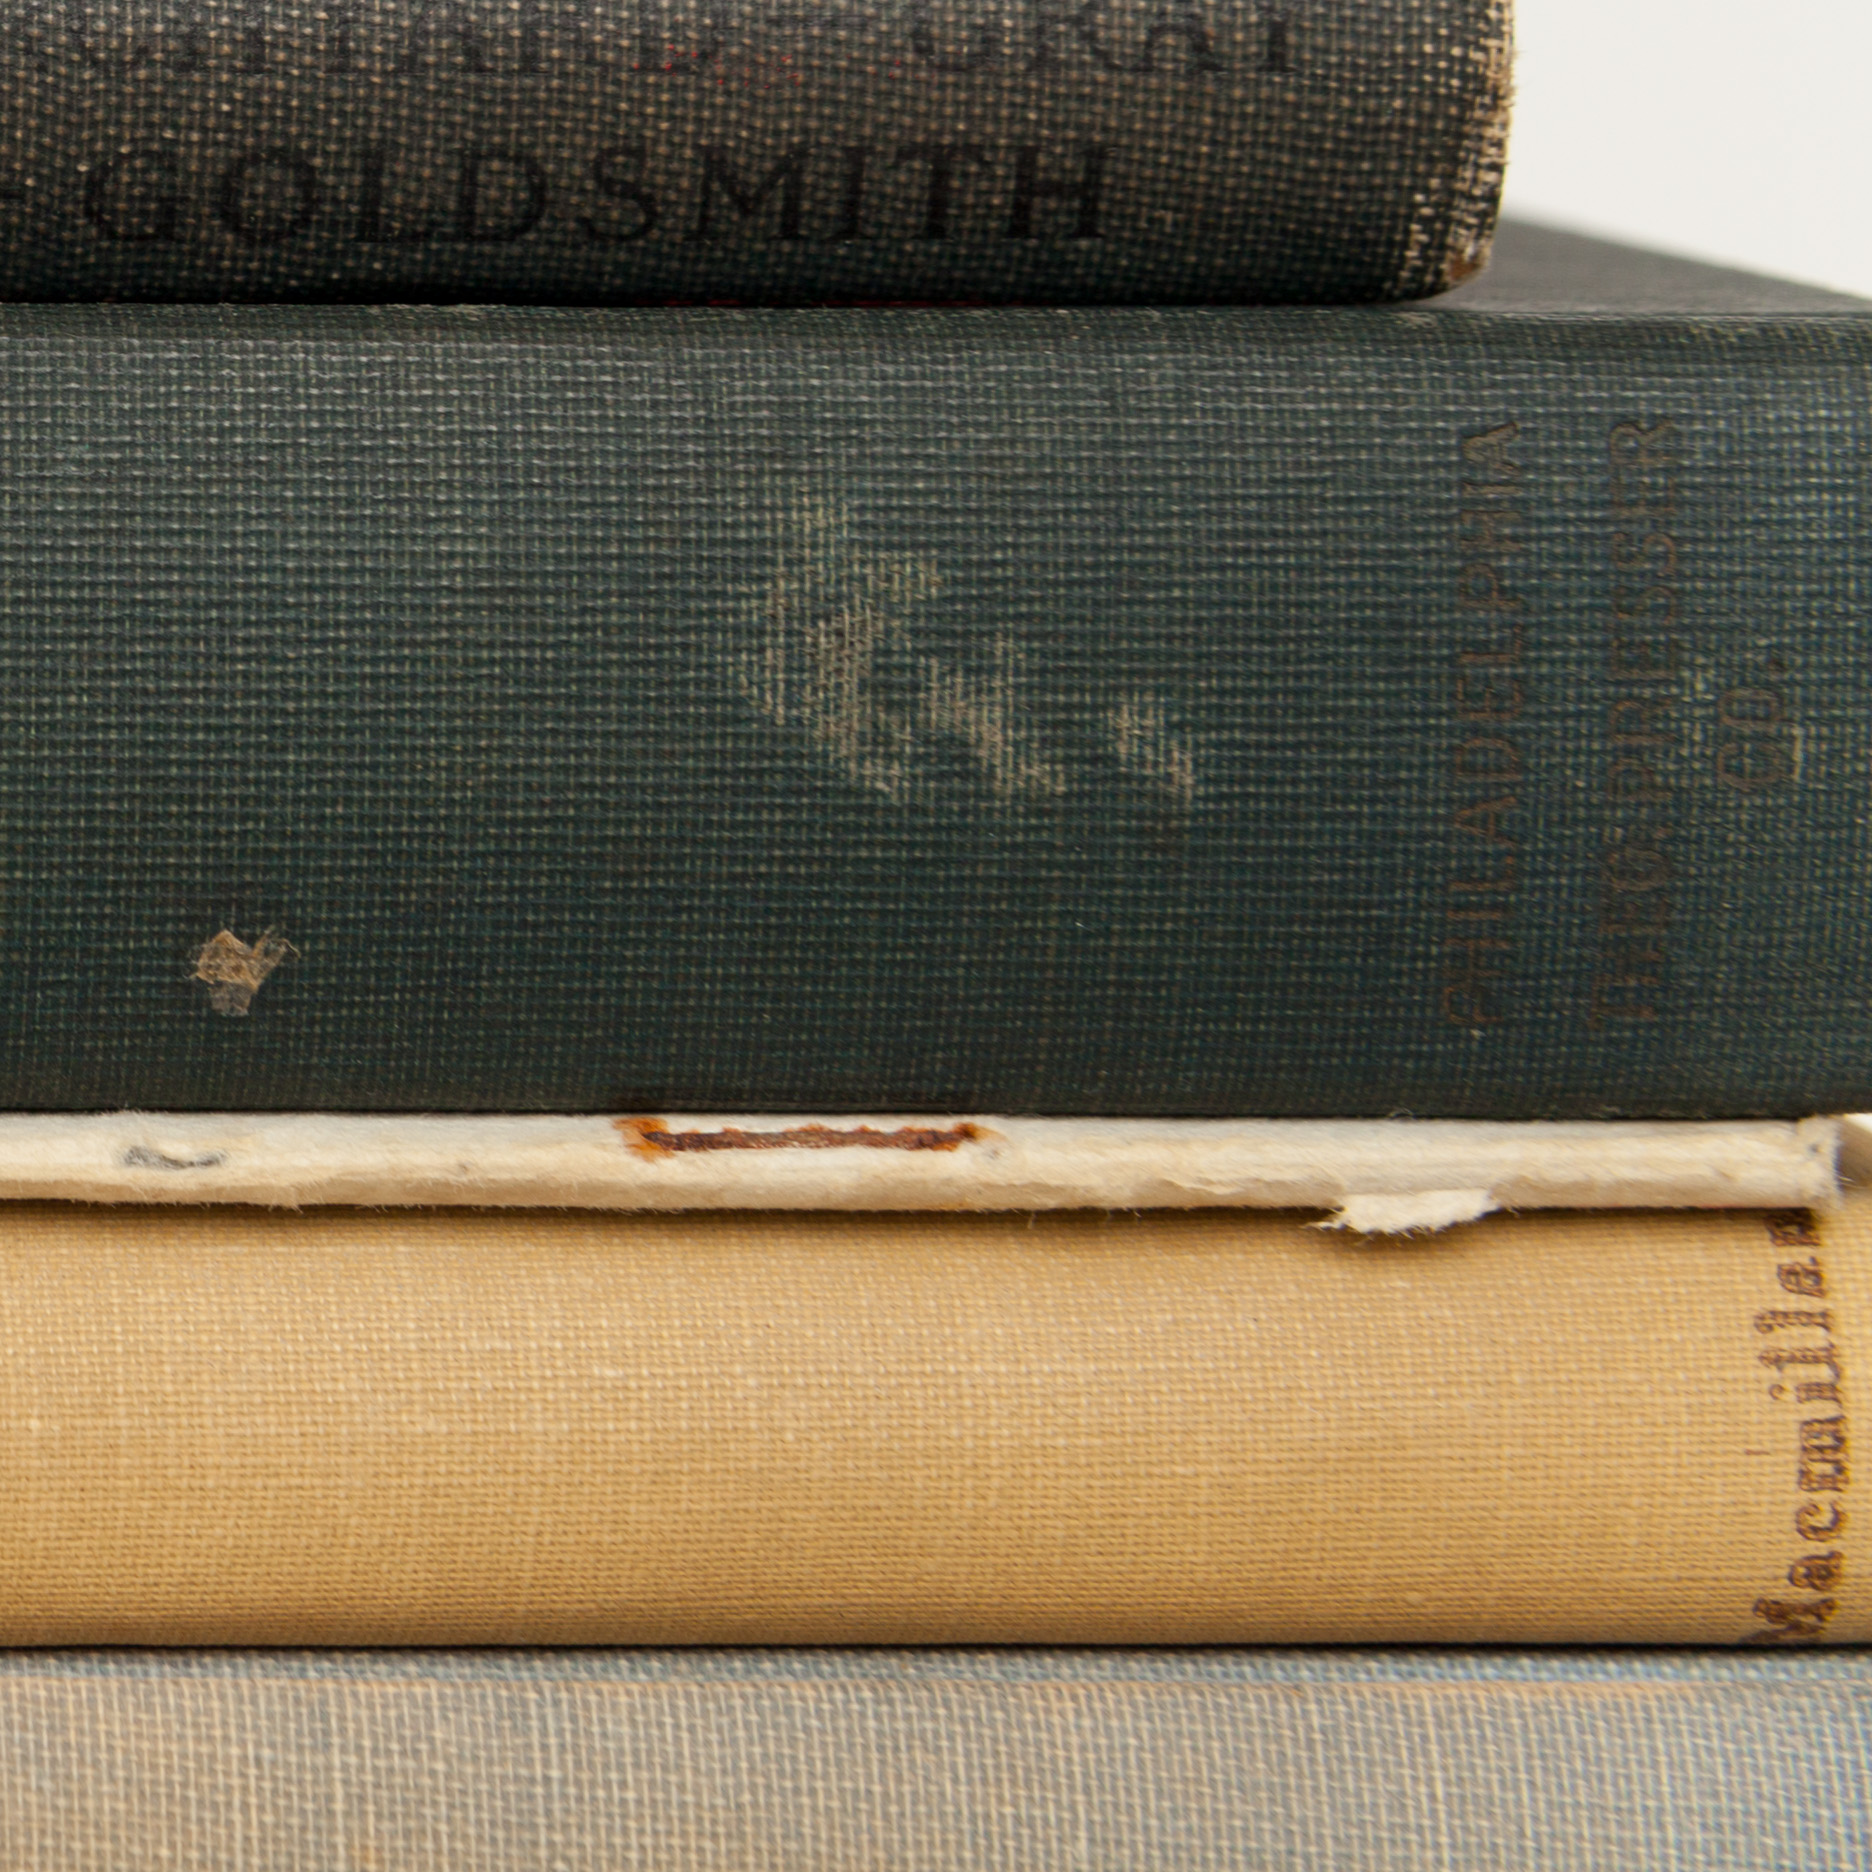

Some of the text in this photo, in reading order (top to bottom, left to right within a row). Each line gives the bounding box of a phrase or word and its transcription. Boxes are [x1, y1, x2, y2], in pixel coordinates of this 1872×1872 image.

[78, 142, 1114, 248] GOLDSMITH
[1440, 418, 1528, 1030] PHILADELPHIA
[1604, 416, 1681, 804] PRESSER
[1714, 652, 1794, 794] CO.
